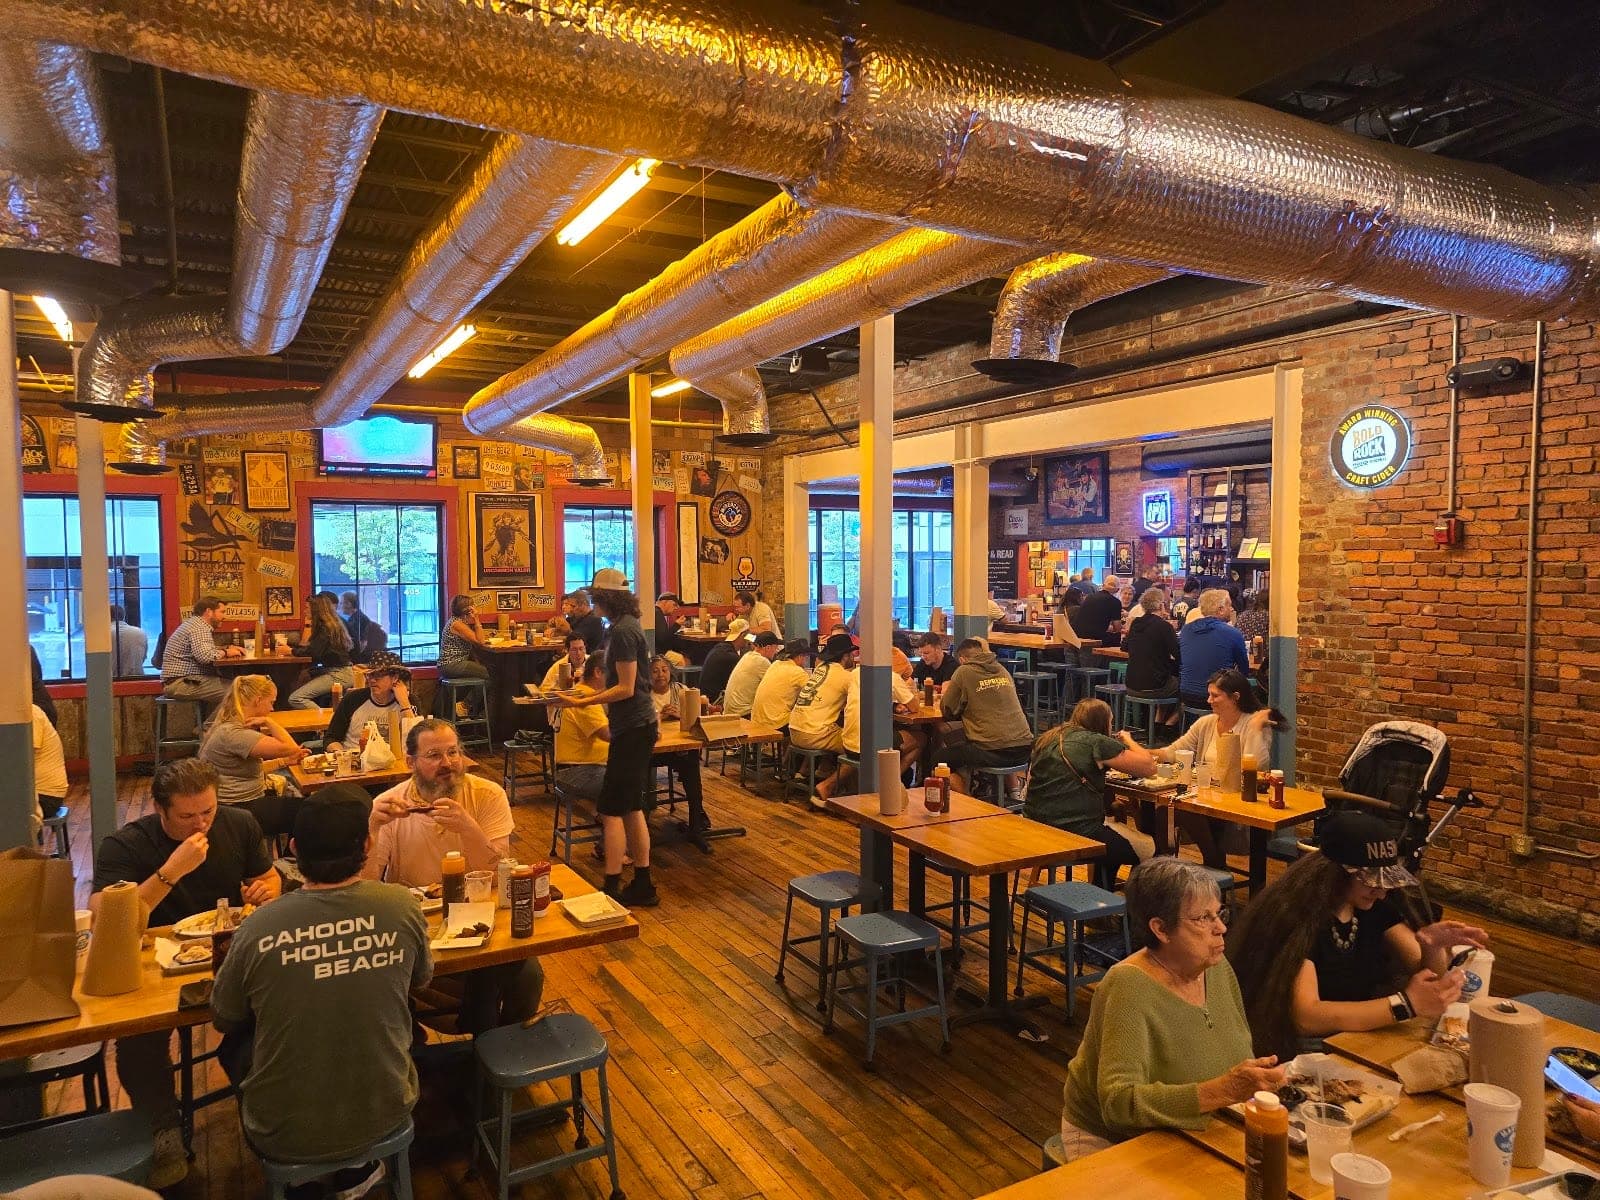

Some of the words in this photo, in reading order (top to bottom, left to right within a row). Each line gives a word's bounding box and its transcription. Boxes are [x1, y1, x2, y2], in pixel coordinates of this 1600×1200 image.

[1339, 412, 1362, 435] AWARD
[1364, 409, 1398, 427] WINNING
[1353, 425, 1383, 448] BOLD
[1354, 436, 1385, 460] ROCK
[1346, 472, 1370, 485] CRAFT
[1371, 465, 1396, 484] CIDER
[184, 549, 242, 562] DELTA
[990, 550, 996, 559] &
[997, 549, 1014, 559] READ
[258, 915, 375, 953] CAHOON
[281, 931, 398, 966] HOLLOW
[314, 949, 404, 980] BEACH
